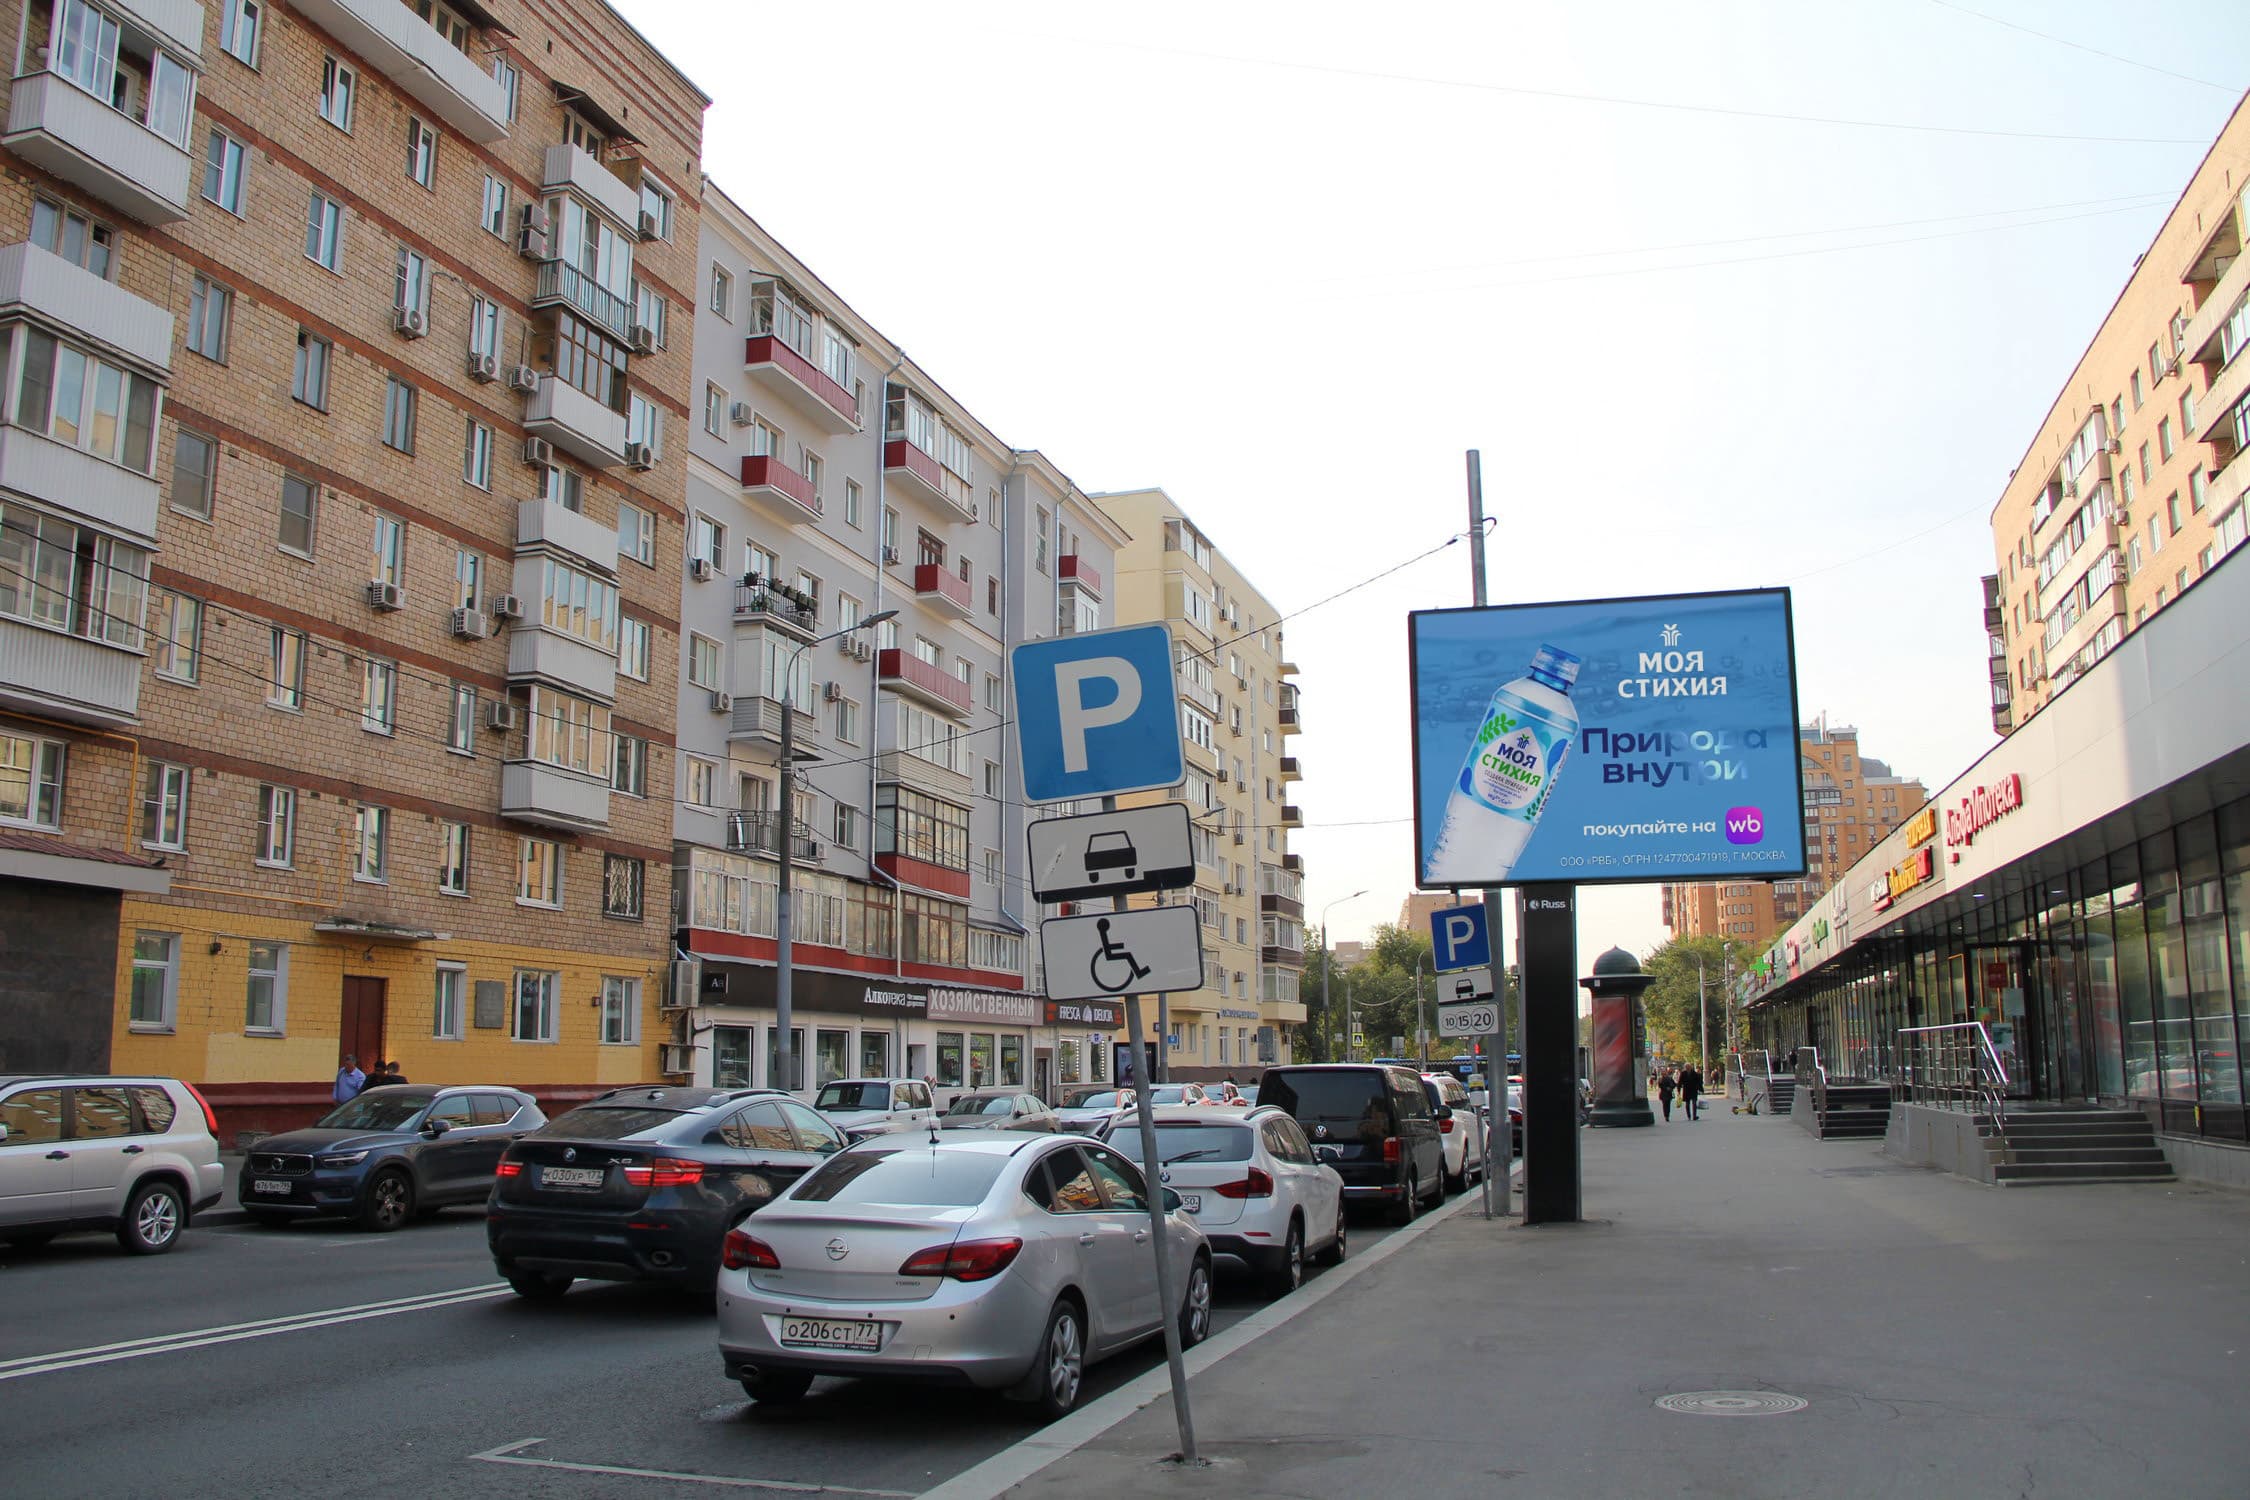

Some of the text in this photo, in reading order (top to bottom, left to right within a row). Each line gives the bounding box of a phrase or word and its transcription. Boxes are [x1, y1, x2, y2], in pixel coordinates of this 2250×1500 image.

[1639, 651, 1704, 673] МОЯ
[1618, 676, 1728, 698] СТИХИЯ
[1055, 656, 1142, 774] P
[1497, 743, 1537, 769] МОЯ
[1482, 753, 1541, 787] СТИХИЯ
[1603, 760, 1748, 787] внутри
[1583, 820, 1716, 837] покупайте на
[1728, 814, 1761, 833] wb
[1560, 857, 1584, 866] ООО
[1622, 854, 1651, 864] ОГРН
[1541, 900, 1566, 909] Russ
[1445, 915, 1475, 962] P
[864, 986, 906, 1007] Алкотека
[930, 988, 1035, 1017] ХОЗЯЙСТВЕННЫЙ
[1060, 1005, 1081, 1020] FRESCA
[1445, 1012, 1492, 1026] 10 15 20
